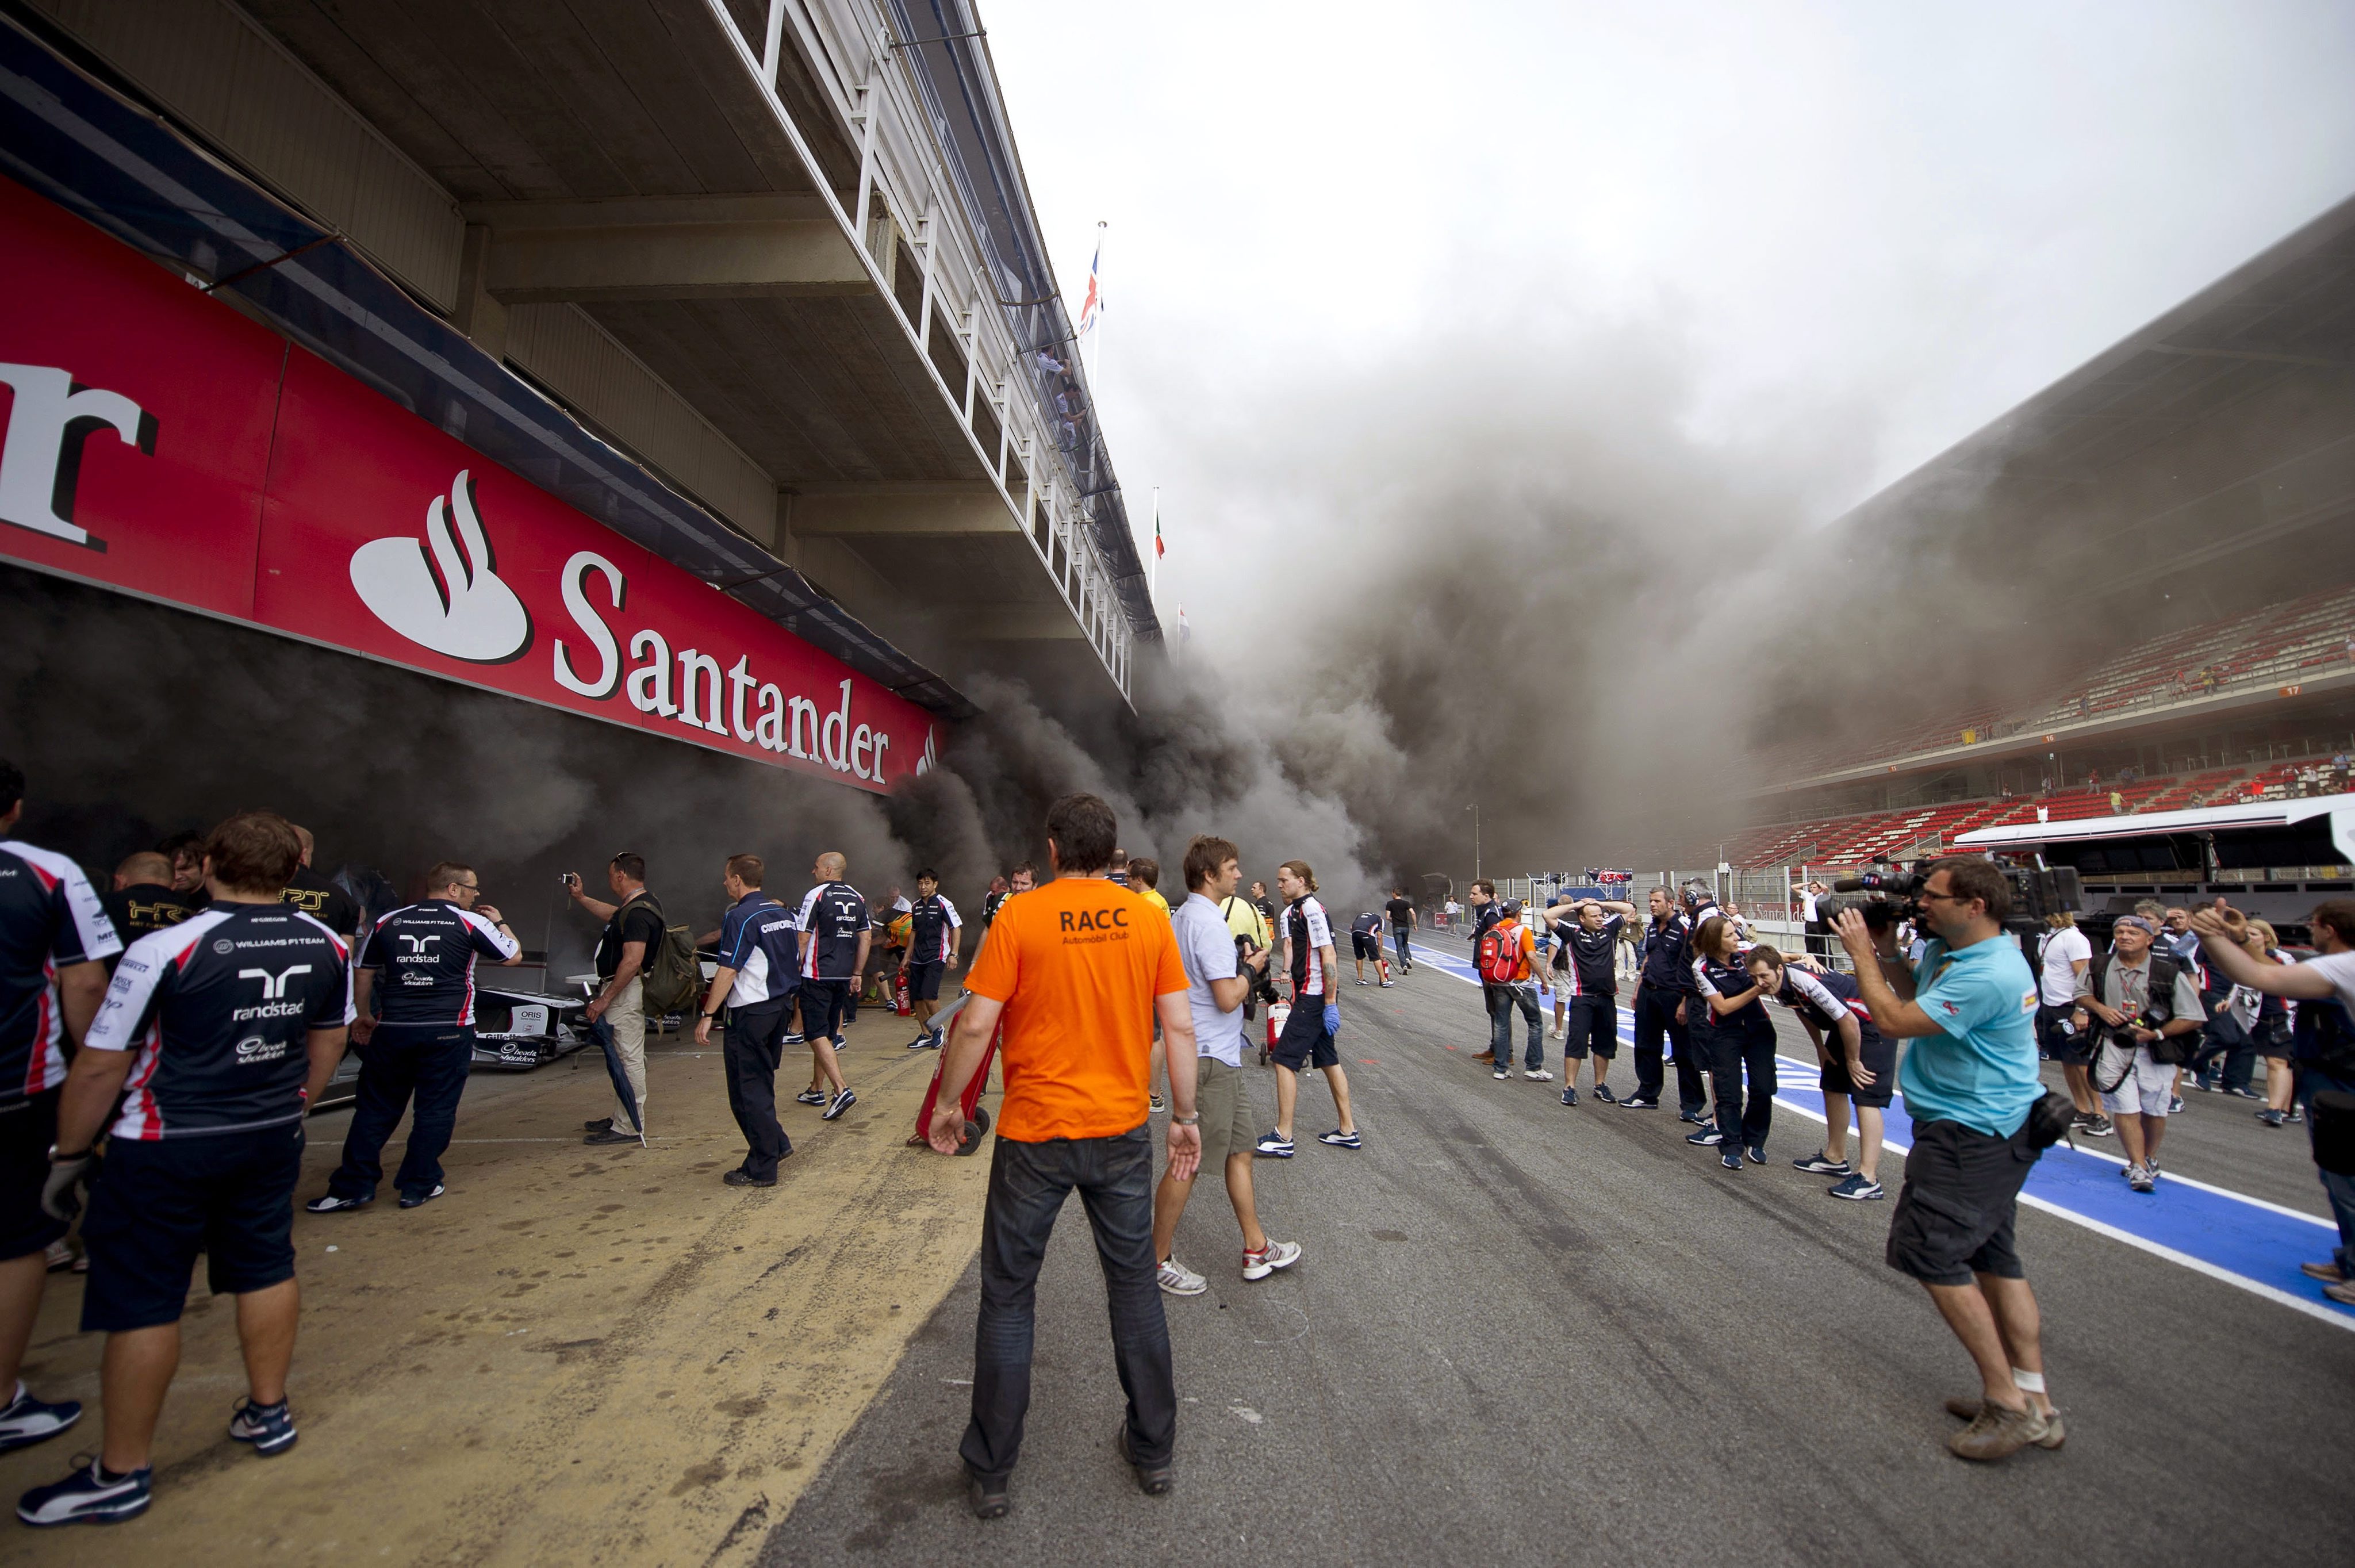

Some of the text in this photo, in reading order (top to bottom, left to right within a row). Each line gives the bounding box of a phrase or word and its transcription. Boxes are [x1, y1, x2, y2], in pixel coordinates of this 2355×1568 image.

[554, 550, 889, 785] Santander
[2287, 685, 2299, 695] 17
[1756, 903, 1805, 922] Santade
[1060, 907, 1129, 931] RACC
[1110, 931, 1130, 941] Club
[235, 939, 287, 949] WILLIAMS
[396, 953, 439, 963] randstad
[233, 998, 306, 1021] randstad
[500, 1055, 536, 1063] shoulders
